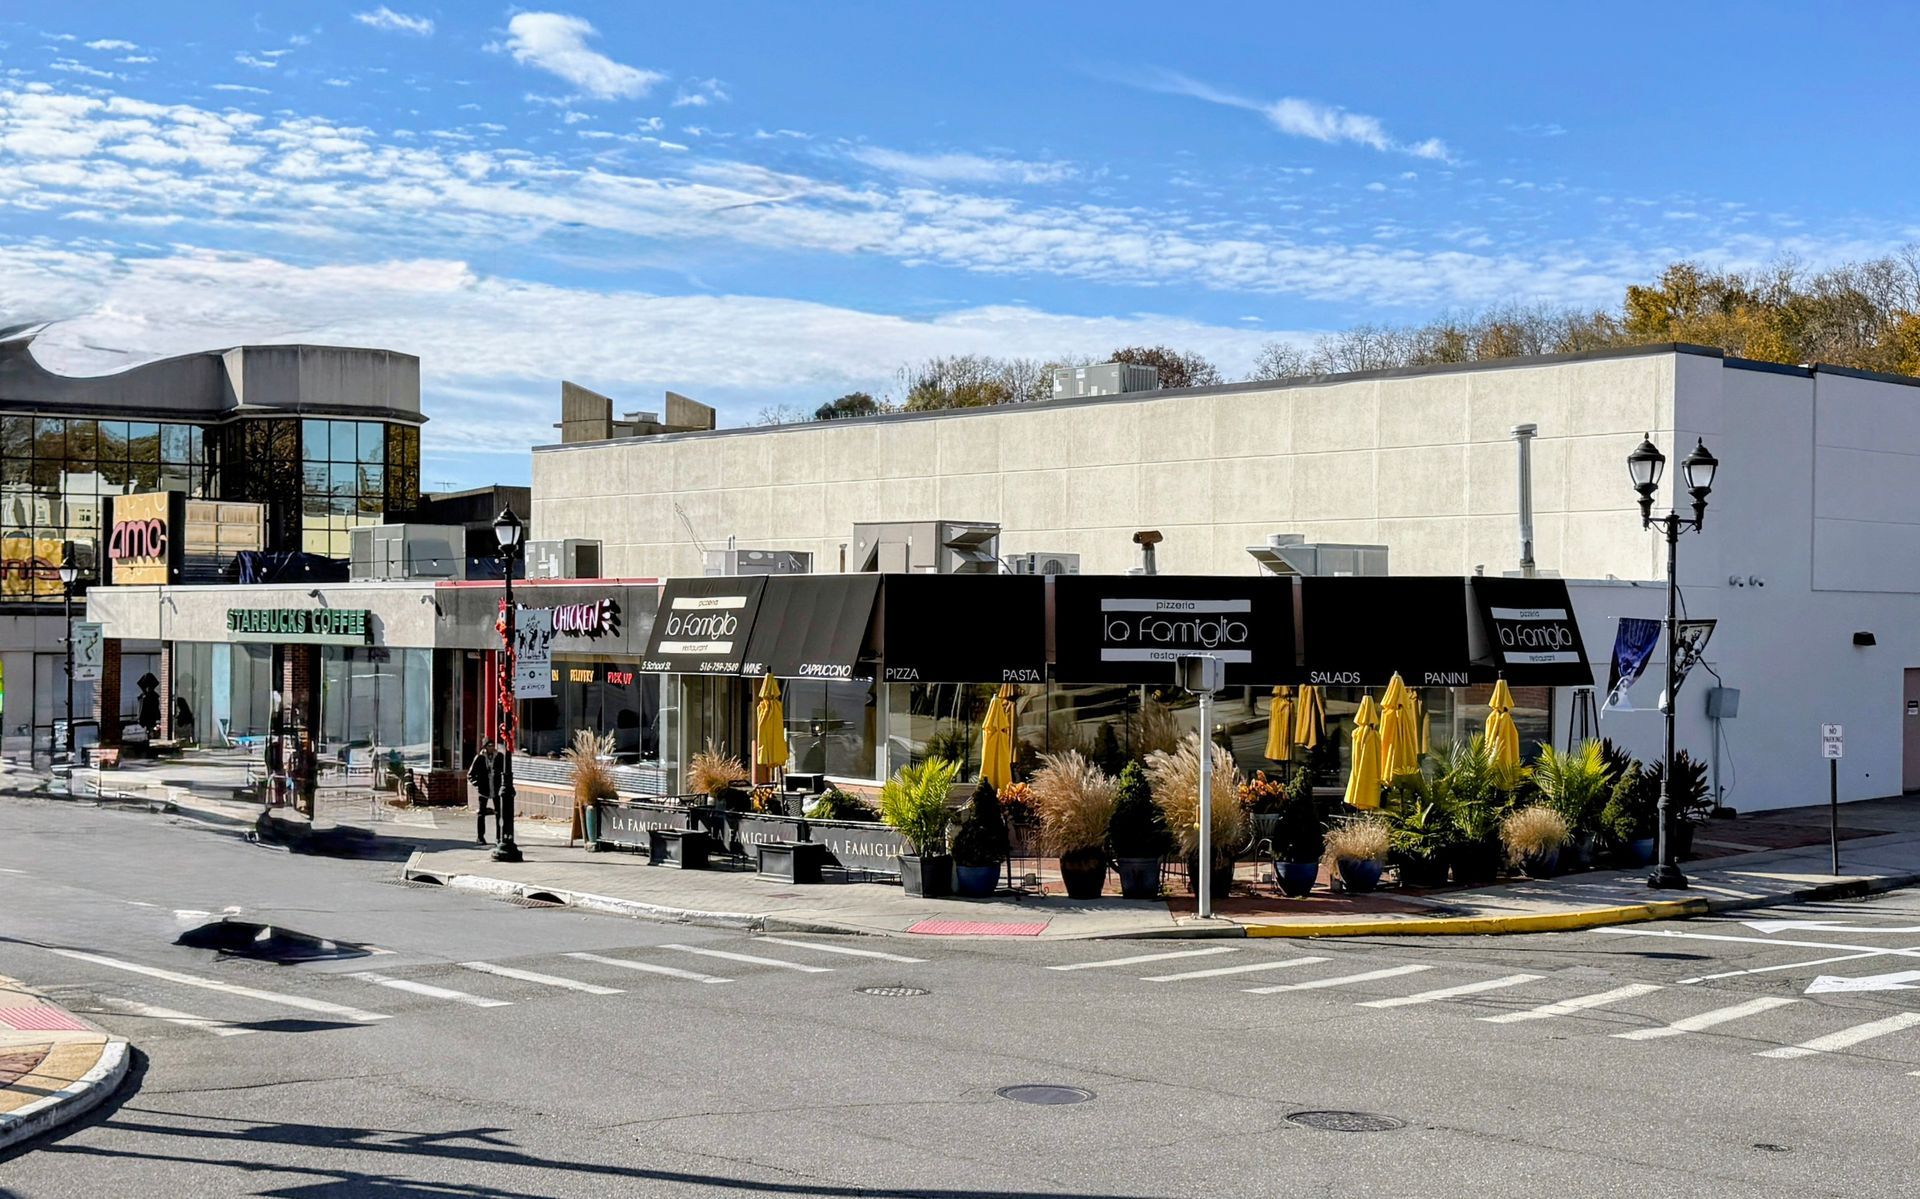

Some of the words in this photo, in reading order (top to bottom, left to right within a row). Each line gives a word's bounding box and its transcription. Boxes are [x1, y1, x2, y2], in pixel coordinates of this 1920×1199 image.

[1156, 600, 1195, 610] pizzeria
[226, 608, 306, 633] STARBUCKS
[311, 608, 365, 634] COFFEE
[552, 600, 601, 635] CHICKEN
[647, 661, 665, 670] School
[743, 663, 762, 675] WINE
[799, 663, 852, 677] CAPPUCCINO
[886, 668, 919, 680] PIZZA
[1003, 669, 1040, 682] PASTA
[1310, 671, 1360, 684] SALADS
[1424, 672, 1468, 684] PANINI
[1829, 727, 1837, 735] NO
[612, 816, 624, 830] LA
[710, 826, 724, 840] LA
[825, 838, 839, 854] LA
